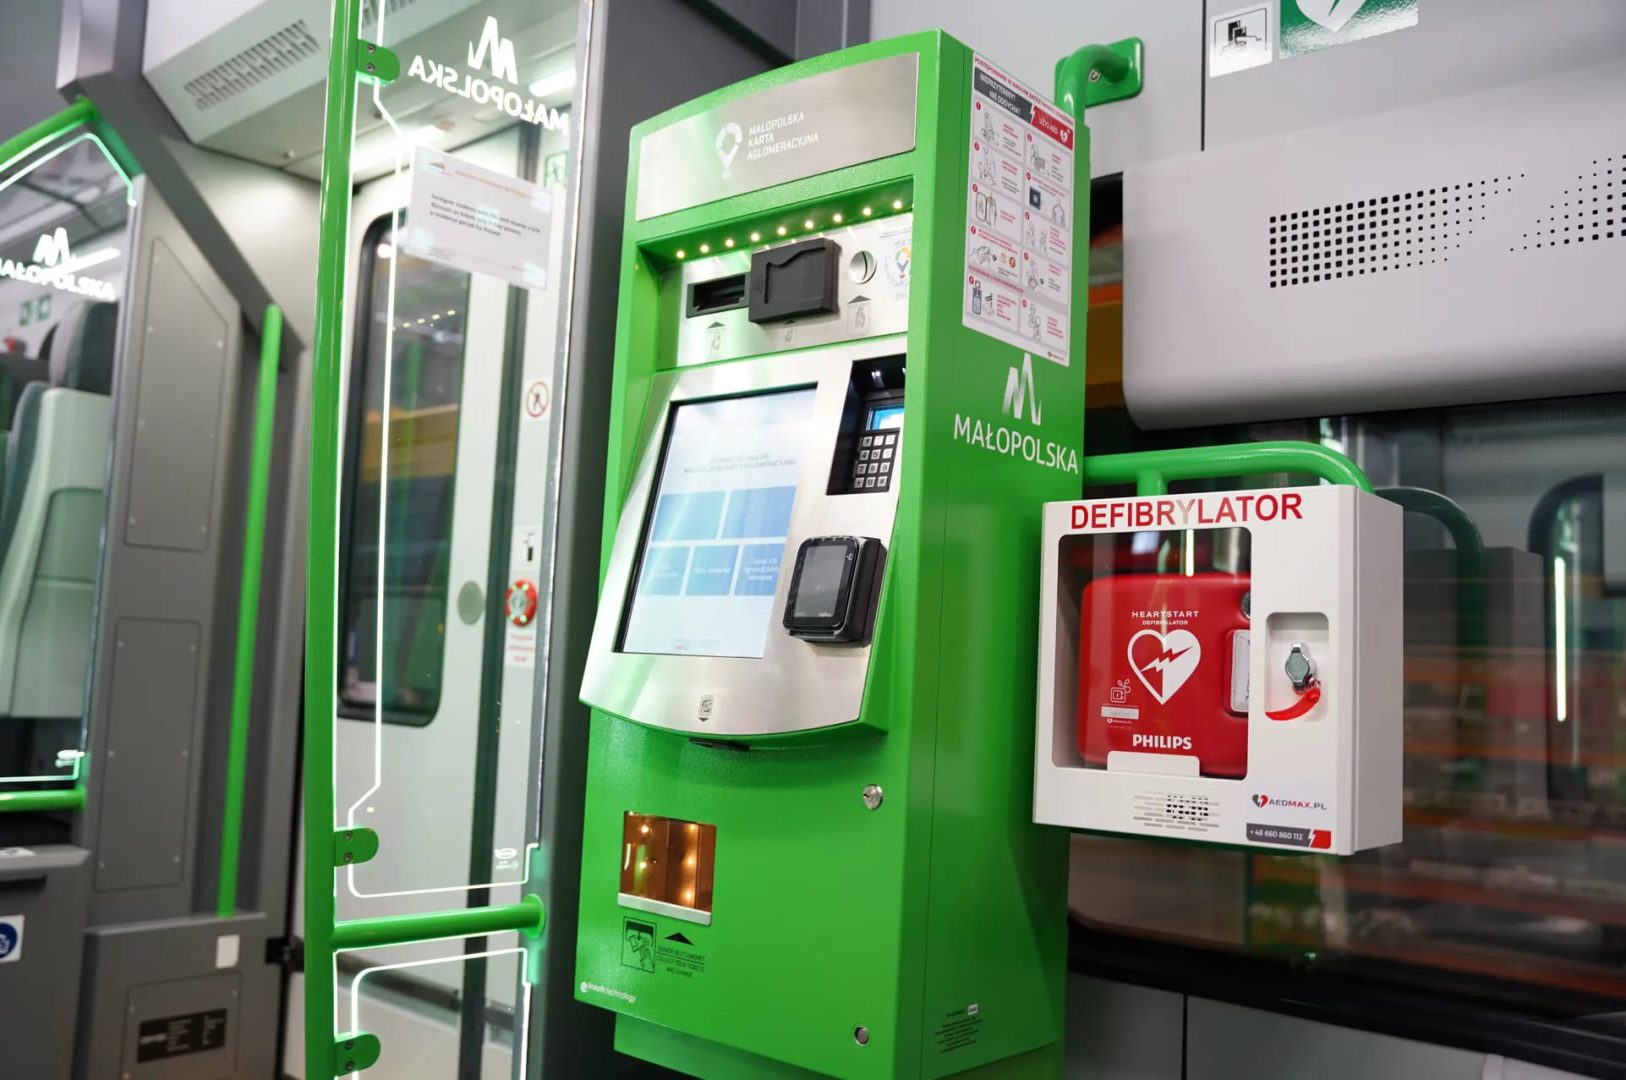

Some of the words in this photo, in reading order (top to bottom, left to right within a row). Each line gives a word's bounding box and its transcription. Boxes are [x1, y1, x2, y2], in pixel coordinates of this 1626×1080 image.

[747, 131, 819, 161] AGLOMERACYJNA
[748, 132, 775, 148] KARTA
[953, 413, 1079, 475] MAŁOPOLSKA
[1071, 493, 1303, 530] DEFIBRYLATOR
[1131, 610, 1200, 618] HEARTSTART
[1132, 734, 1192, 750] PHILIPS
[1269, 798, 1327, 810] AEDMAX.PL
[1293, 833, 1304, 841] 112
